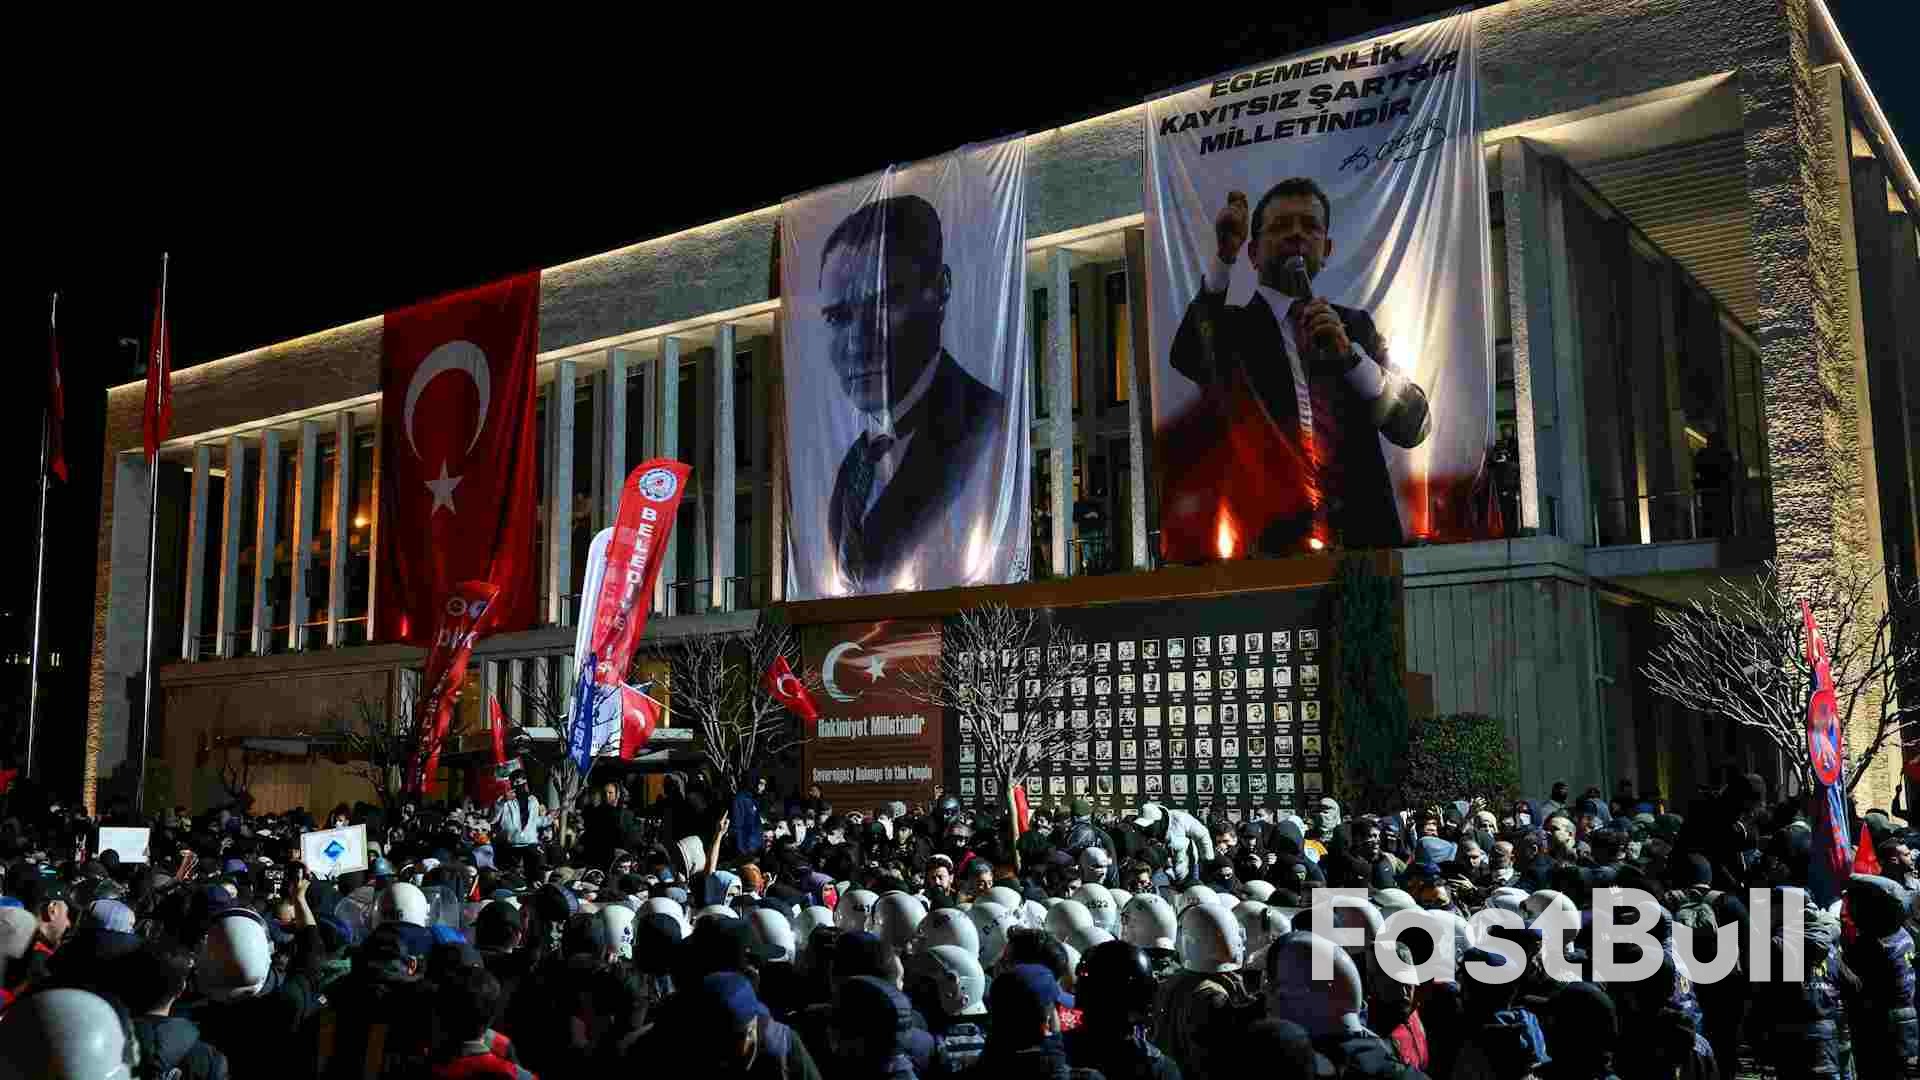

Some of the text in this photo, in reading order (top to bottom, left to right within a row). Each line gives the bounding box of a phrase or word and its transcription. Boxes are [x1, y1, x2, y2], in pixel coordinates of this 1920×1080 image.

[1160, 50, 1458, 136] KAYITSIZ ŞARTSIZ
[1210, 41, 1405, 98] EGEMENLİK
[1200, 97, 1412, 155] MİLLETİNDİR
